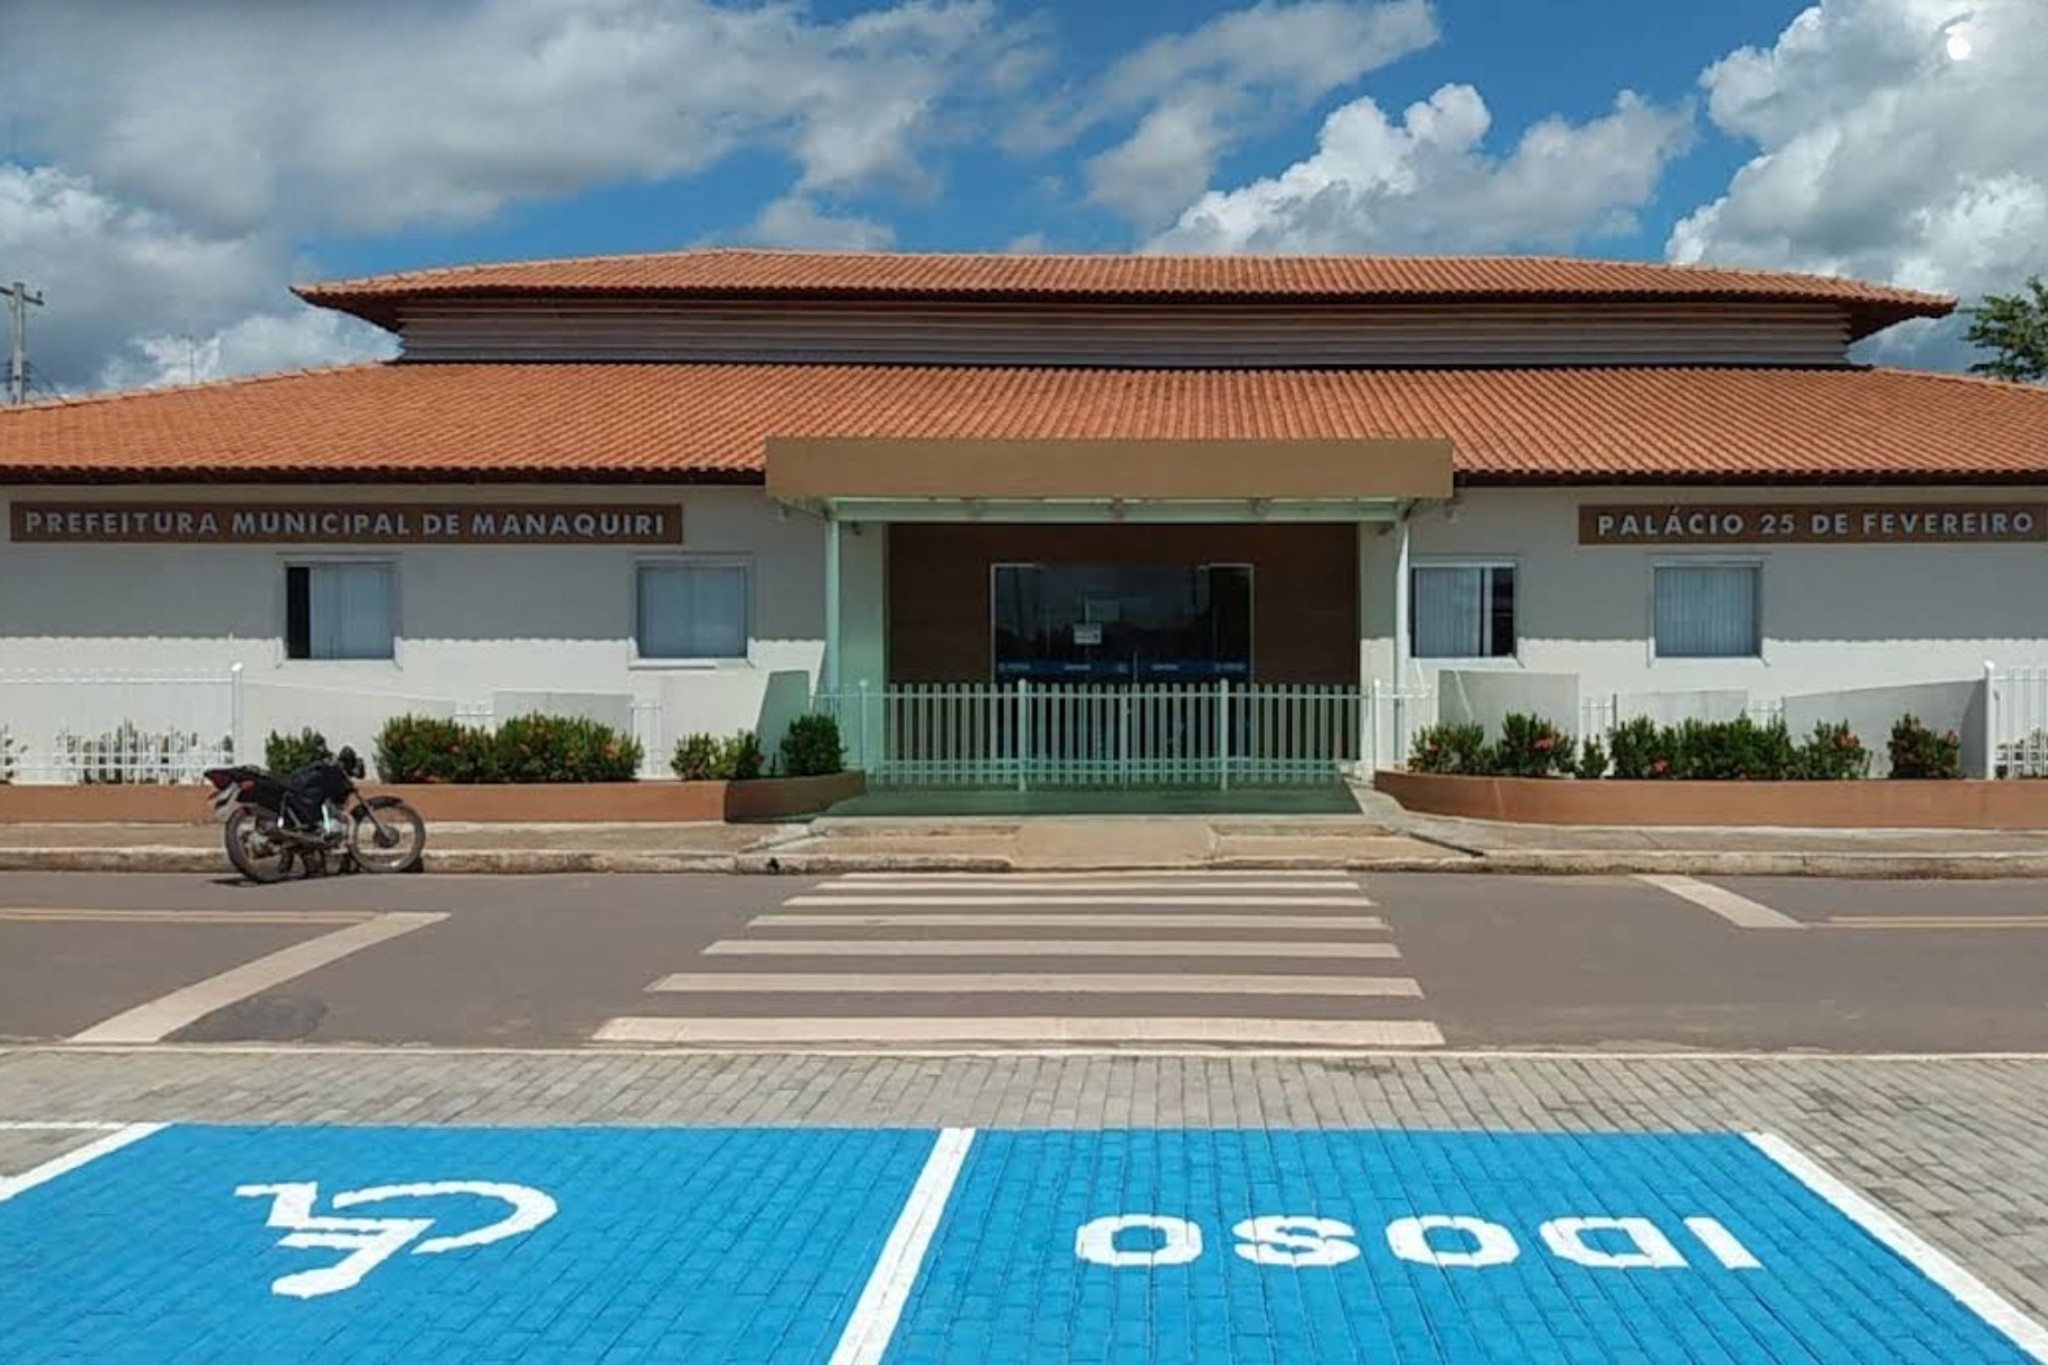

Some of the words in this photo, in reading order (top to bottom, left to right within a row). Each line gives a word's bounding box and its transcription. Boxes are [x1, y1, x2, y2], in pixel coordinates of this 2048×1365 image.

[25, 512, 218, 533] PREFEITURA
[231, 512, 410, 534] MUNICIPAL
[422, 513, 459, 534] DE
[471, 513, 665, 535] MANAQUIRI
[1597, 507, 1744, 535] PALÁCIO
[1760, 513, 1795, 534] 25
[1811, 513, 1848, 534] DE
[1862, 511, 2034, 533] FEVEREIRO
